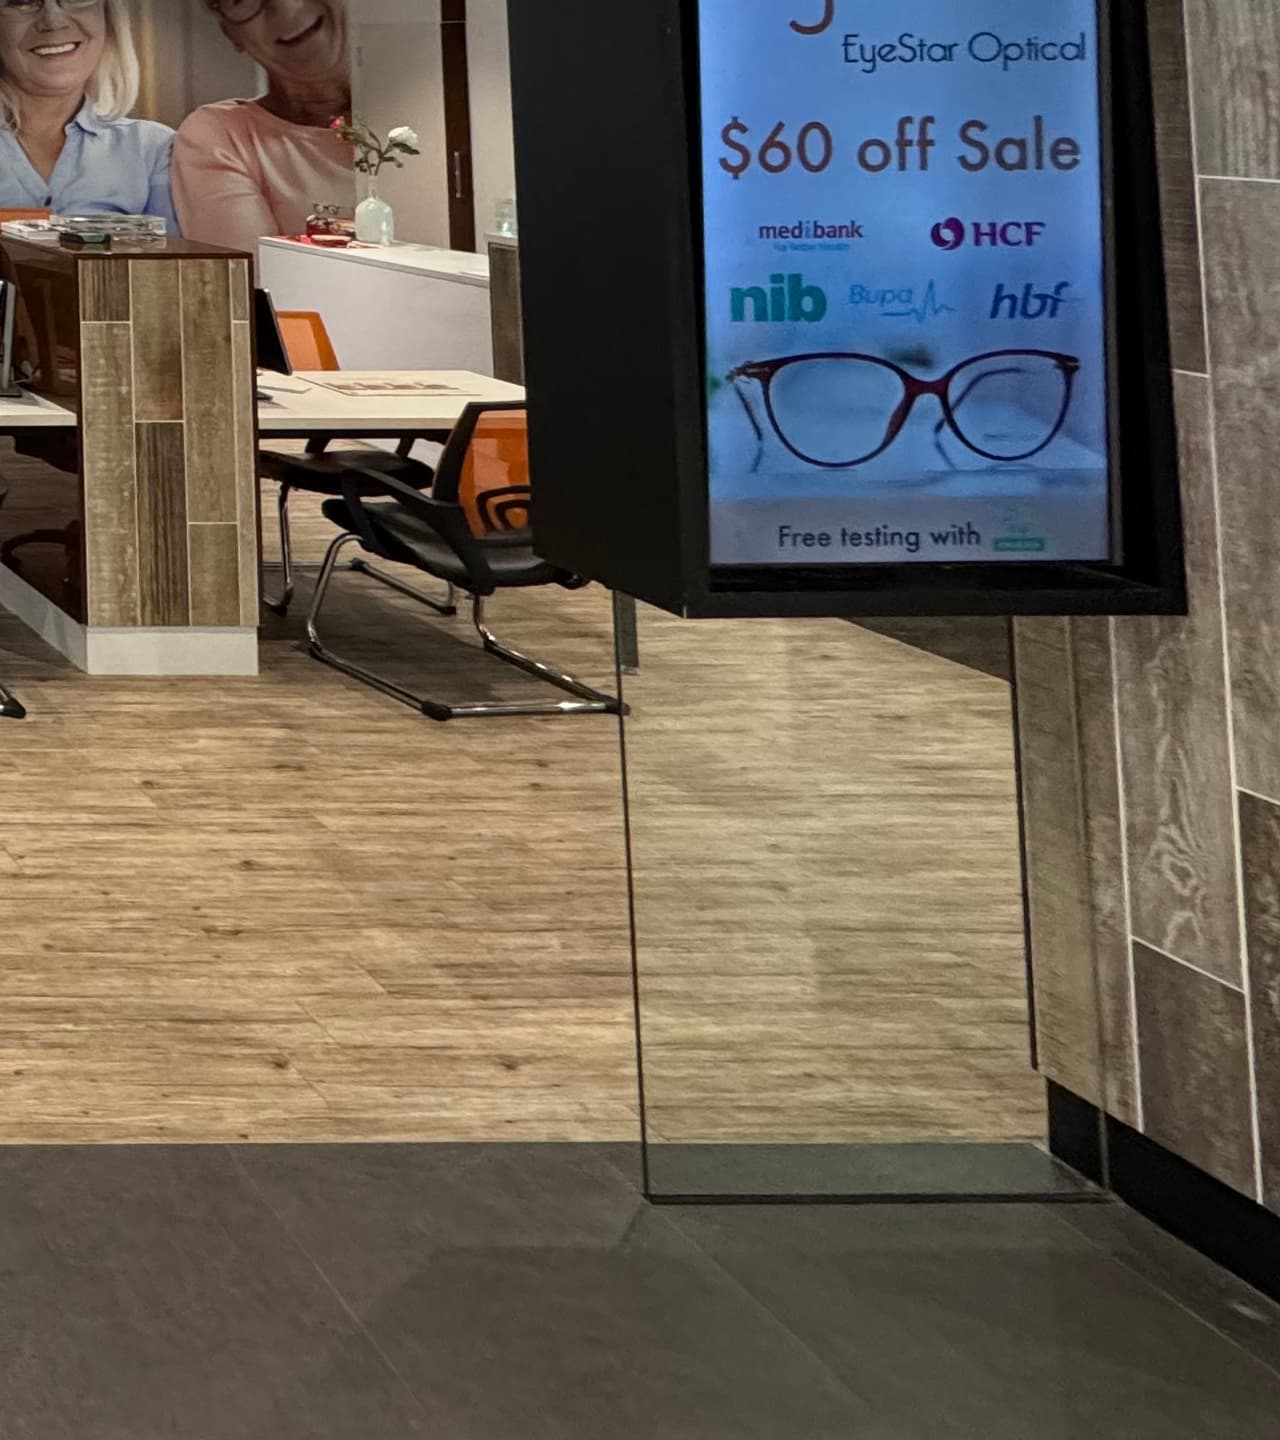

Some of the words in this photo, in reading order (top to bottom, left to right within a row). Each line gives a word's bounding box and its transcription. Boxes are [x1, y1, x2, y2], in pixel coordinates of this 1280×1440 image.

[842, 33, 960, 74] EyeStar
[968, 31, 1085, 70] Optical
[719, 116, 833, 180] $60
[857, 116, 936, 172] off
[957, 115, 1081, 172] Sale
[759, 220, 864, 239] medibank
[972, 222, 1046, 247] HCF
[730, 274, 827, 322] nib
[849, 284, 913, 307] Bupa
[990, 281, 1072, 319] hbf
[778, 525, 832, 547] Free
[841, 525, 920, 552] testing
[929, 522, 981, 546] with
